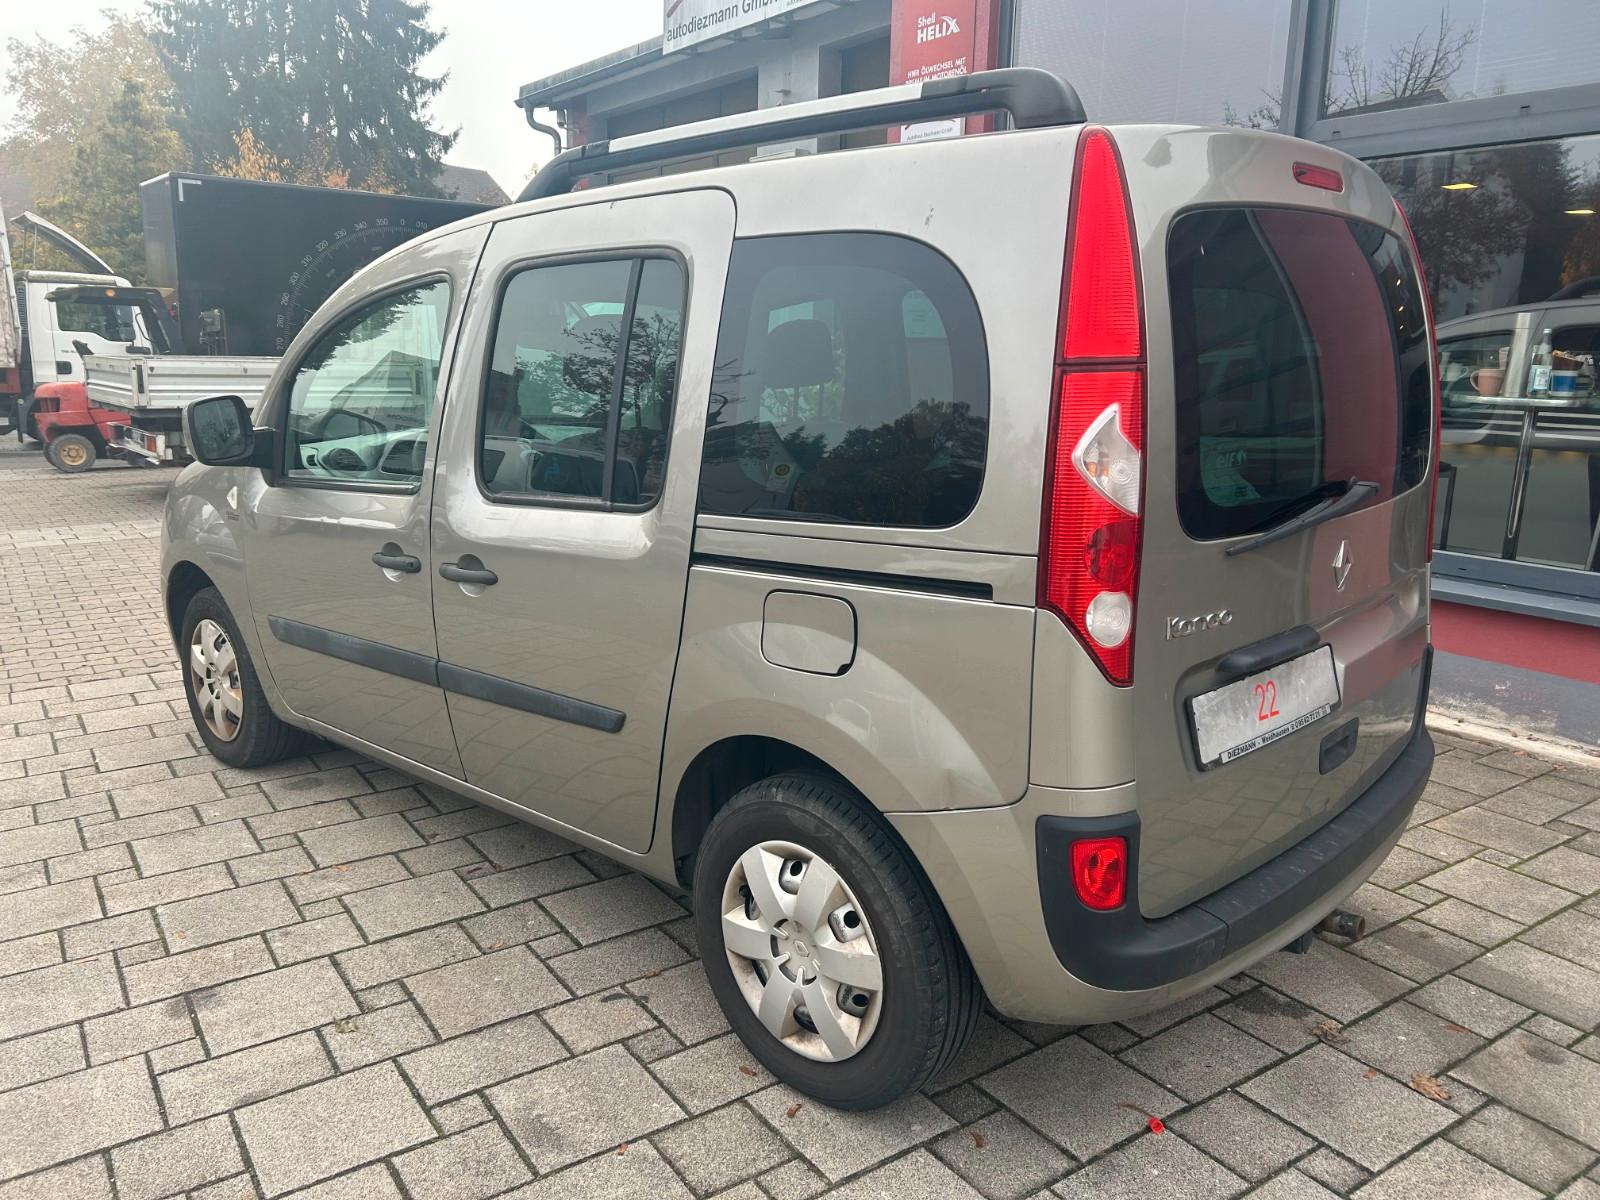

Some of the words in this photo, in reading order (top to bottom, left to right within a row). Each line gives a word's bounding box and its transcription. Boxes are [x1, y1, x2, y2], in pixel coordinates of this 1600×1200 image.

[667, 4, 738, 42] autodiezmann
[742, 0, 778, 13] Gm
[917, 12, 936, 28] Shell
[917, 15, 960, 44] HELIX
[907, 69, 920, 79] HIER
[921, 60, 954, 75] ÖLWECHSEL
[955, 56, 966, 66] MIT
[353, 220, 367, 231] 340
[375, 218, 389, 227] 350
[415, 221, 428, 230] 010
[1254, 680, 1280, 721] 22
[1227, 742, 1256, 759] DIEZMANN
